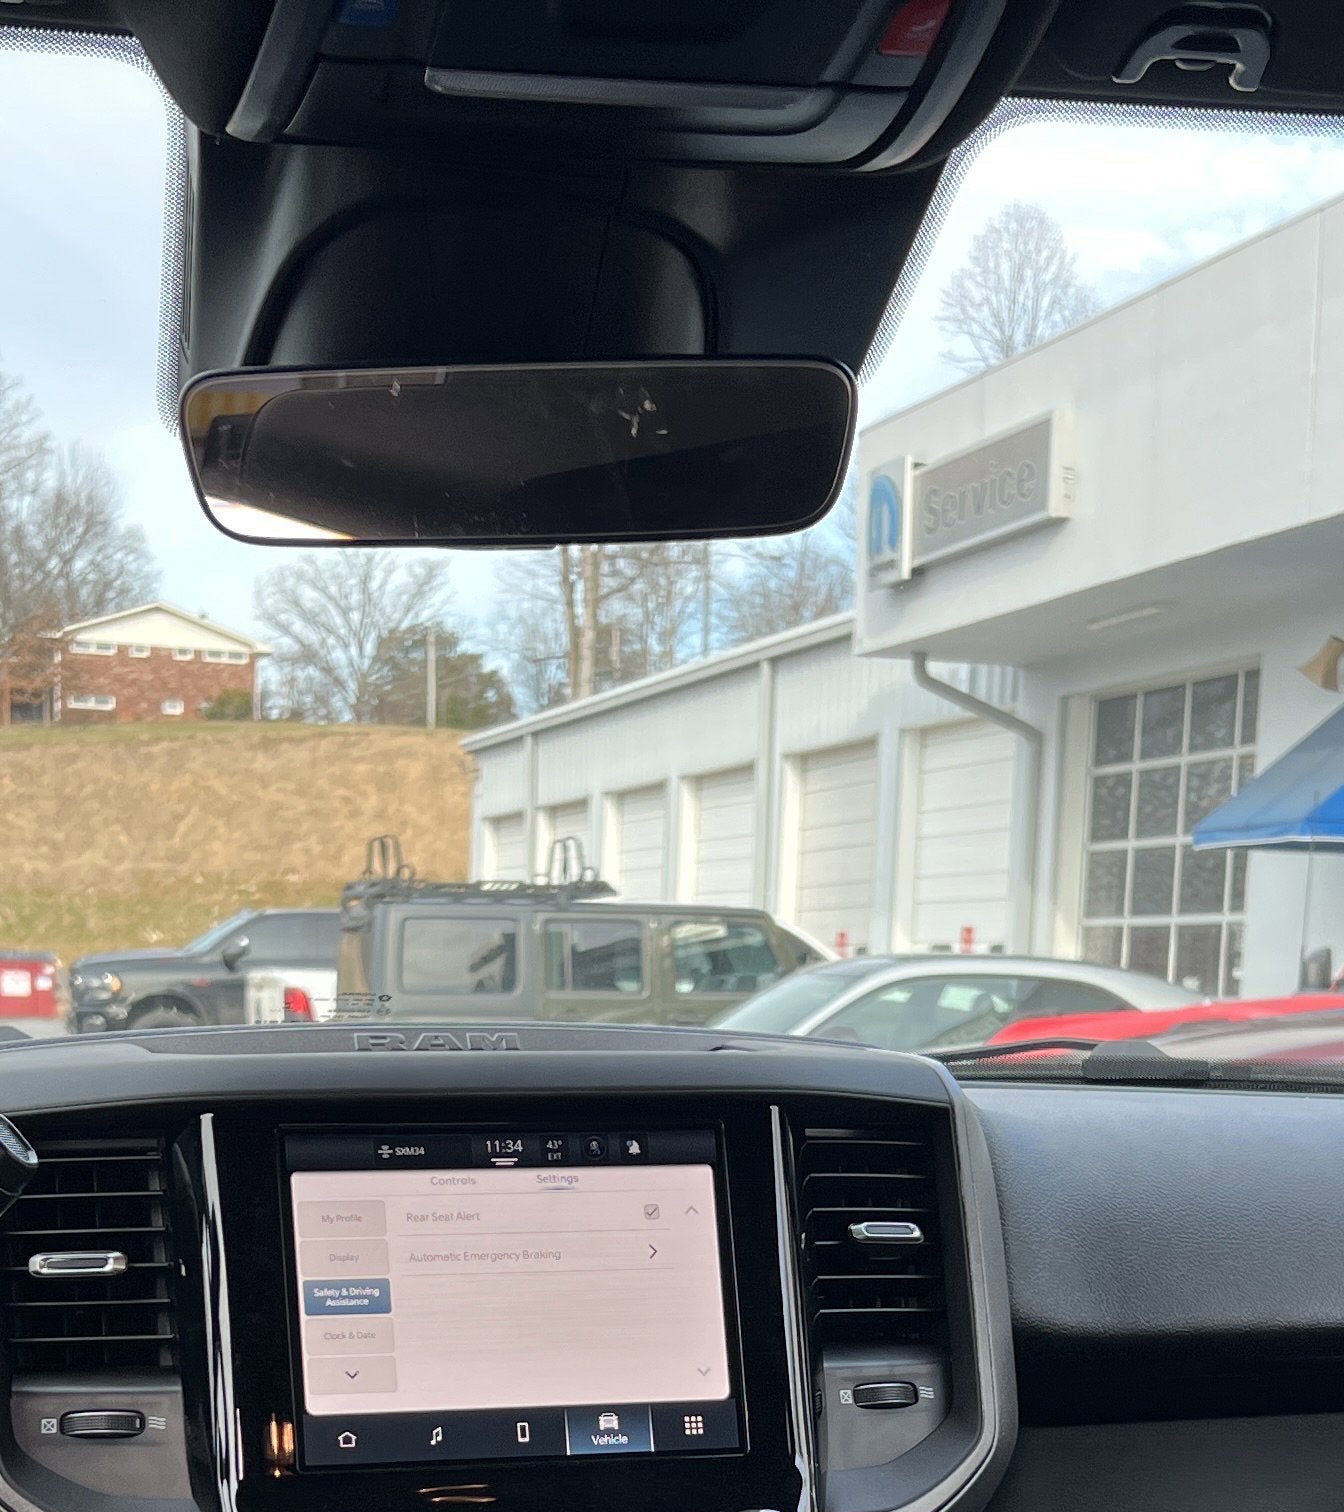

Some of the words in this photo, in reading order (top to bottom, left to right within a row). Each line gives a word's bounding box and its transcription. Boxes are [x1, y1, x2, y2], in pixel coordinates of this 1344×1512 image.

[923, 460, 1037, 536] Service
[354, 1032, 520, 1050] RAM
[486, 1140, 523, 1153] 11:34
[548, 1152, 562, 1161] EXT
[430, 1175, 476, 1186] Controls
[536, 1172, 579, 1186] Settings
[321, 1215, 334, 1224] My
[336, 1214, 362, 1222] Profile
[406, 1213, 429, 1222] Rear
[432, 1212, 454, 1221] Seat
[456, 1211, 480, 1221] Alert
[329, 1253, 359, 1262] Display
[409, 1251, 461, 1262] Automatic
[463, 1250, 520, 1262] Emergency
[522, 1249, 561, 1261] Braking
[313, 1287, 339, 1297] Safety
[341, 1287, 348, 1296] &
[349, 1286, 380, 1297] Driving
[325, 1298, 369, 1307] Assistance
[323, 1332, 346, 1340] Clock
[348, 1332, 355, 1340] &
[357, 1331, 376, 1340] Date
[591, 1433, 629, 1445] Vehicle
